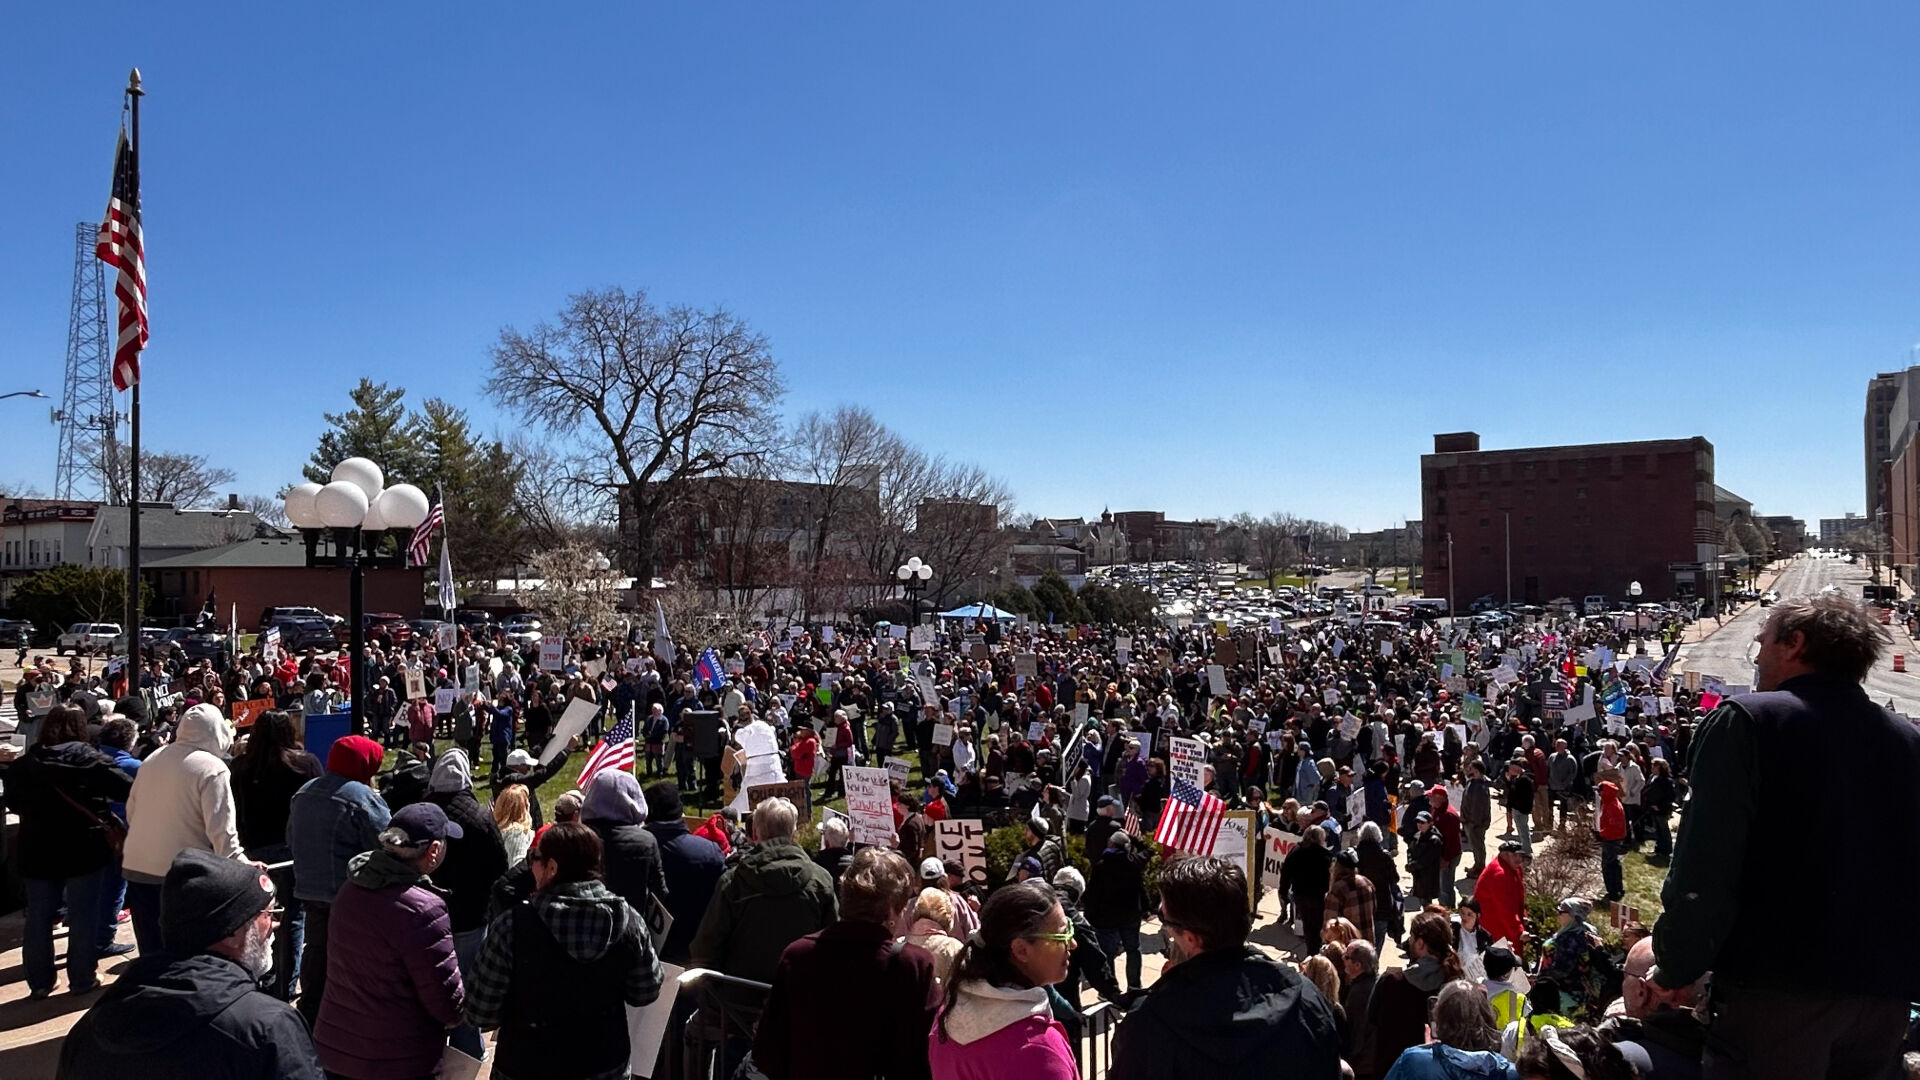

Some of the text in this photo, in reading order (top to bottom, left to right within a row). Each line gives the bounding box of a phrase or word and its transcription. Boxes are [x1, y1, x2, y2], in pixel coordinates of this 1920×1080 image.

[407, 670, 421, 678] NO
[153, 684, 170, 699] NO
[1175, 741, 1196, 749] TRUMP
[964, 825, 988, 886] OUT
[1264, 857, 1282, 875] KIN
